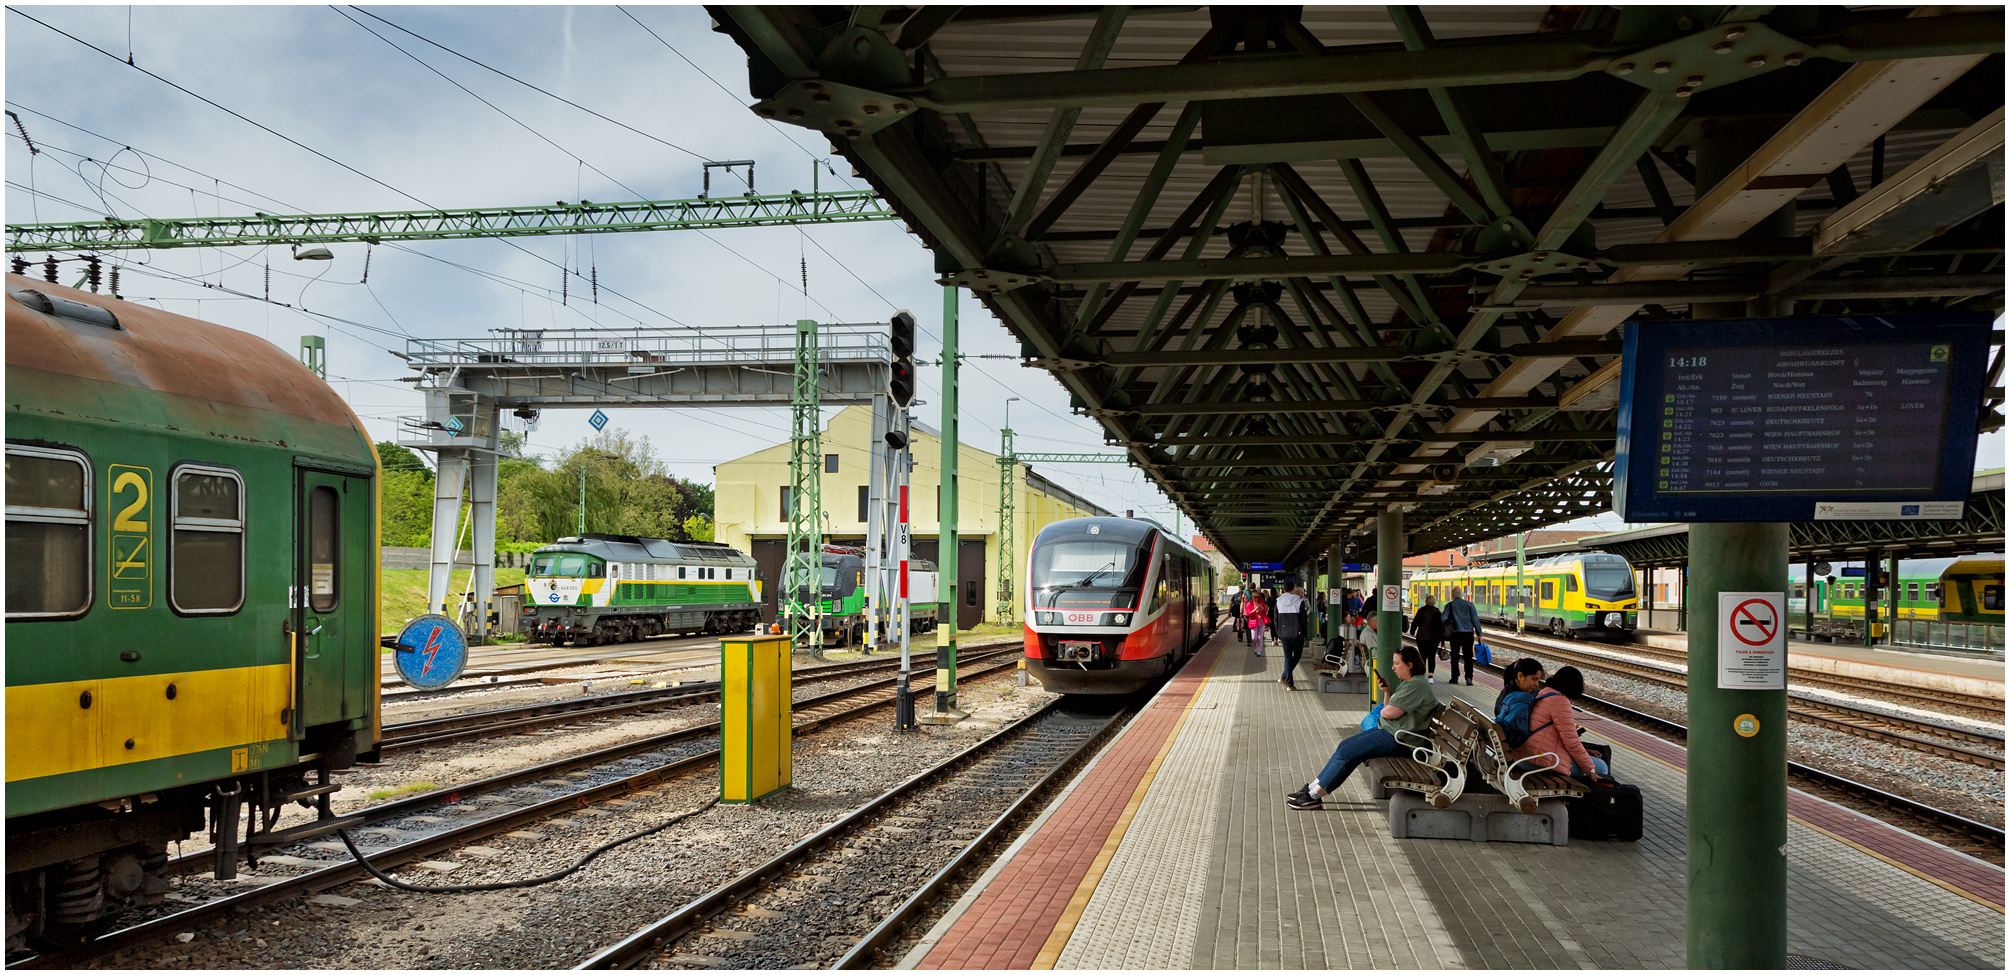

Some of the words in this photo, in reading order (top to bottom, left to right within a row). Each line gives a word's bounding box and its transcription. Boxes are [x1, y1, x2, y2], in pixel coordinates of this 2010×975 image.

[1669, 356, 1707, 367] 14:18
[1731, 383, 1745, 391] Zug
[1773, 381, 1806, 389] Nach/Von
[1853, 379, 1888, 387] Bahnsteig
[1761, 455, 1821, 463] DEUTSCHKREUTZ
[113, 471, 148, 532] 2
[1242, 561, 1252, 570] 7b
[1361, 562, 1371, 571] 5b
[1068, 613, 1094, 622] ÖBB
